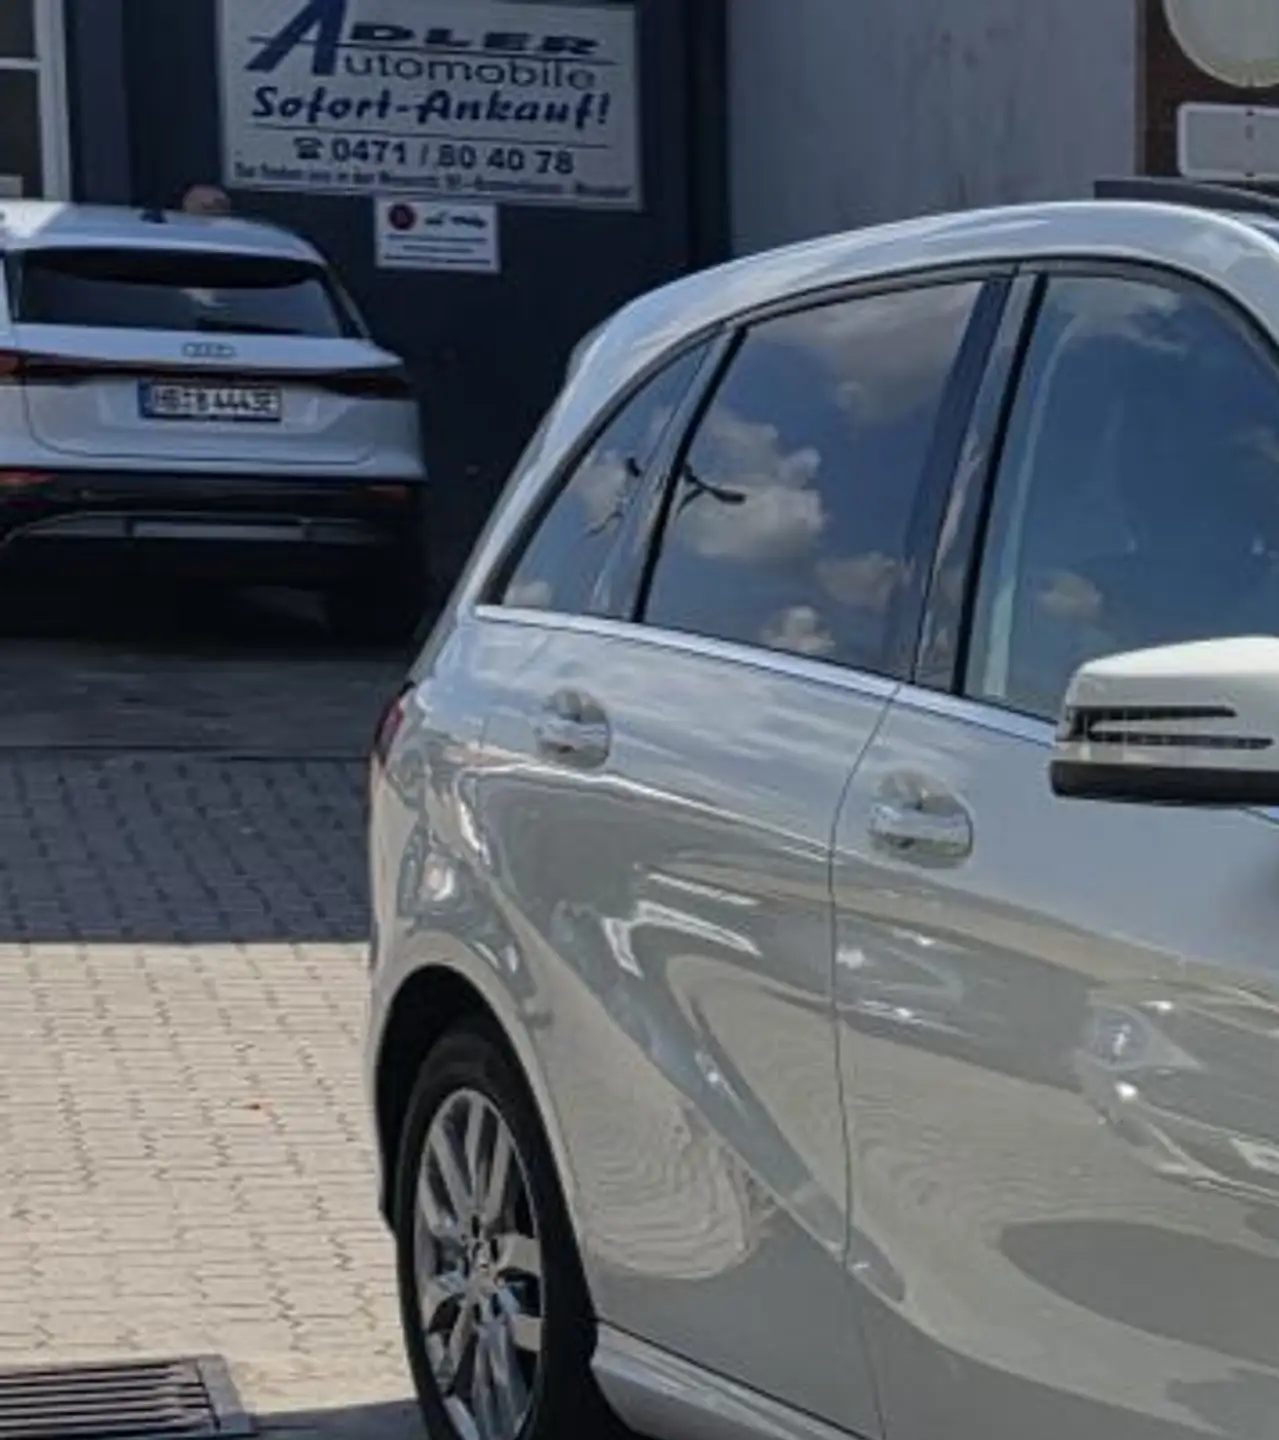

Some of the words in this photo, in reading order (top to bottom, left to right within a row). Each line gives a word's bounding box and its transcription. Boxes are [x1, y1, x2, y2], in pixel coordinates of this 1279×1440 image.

[244, 0, 600, 76] ADLER
[252, 85, 611, 131] Sofort-Ankauf!
[331, 137, 407, 166] 0471
[438, 143, 477, 170] 80
[486, 146, 525, 172] 40
[534, 149, 574, 175] 78
